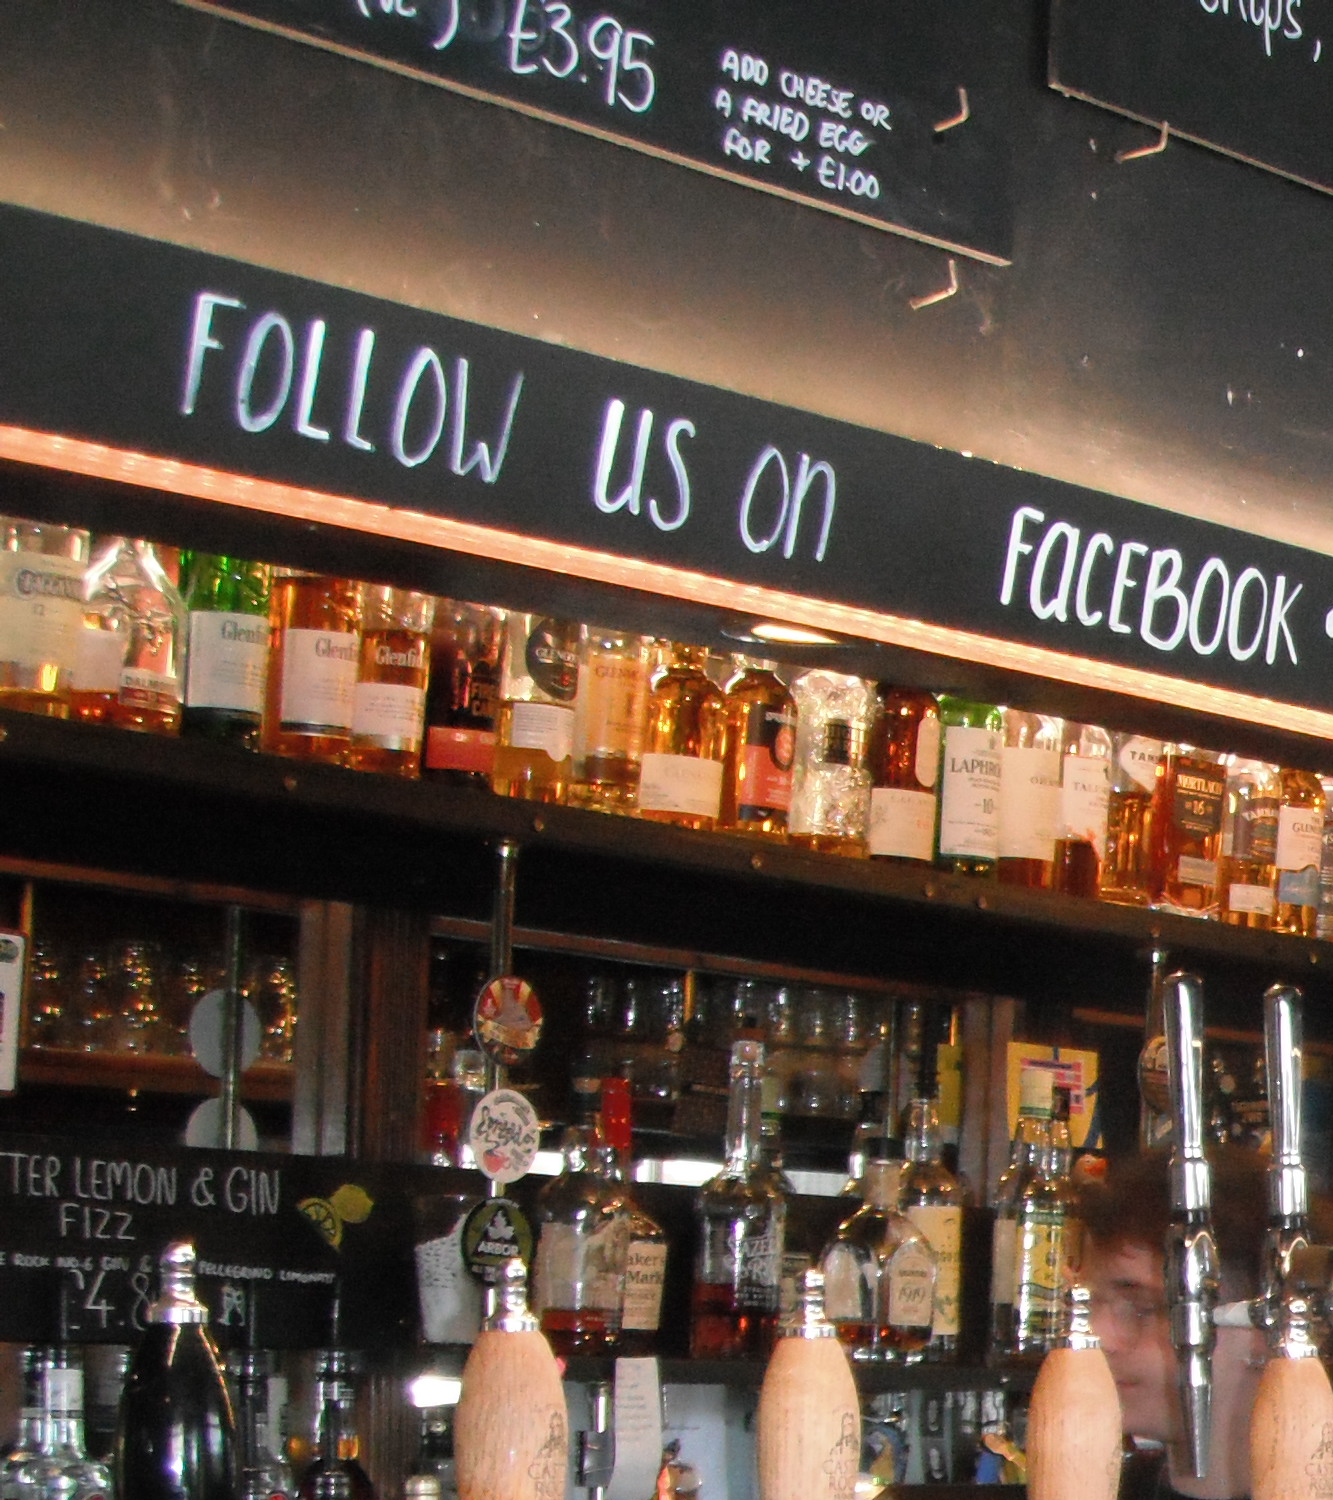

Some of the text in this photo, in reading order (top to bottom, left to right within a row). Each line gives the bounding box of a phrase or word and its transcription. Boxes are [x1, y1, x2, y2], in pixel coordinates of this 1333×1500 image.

[716, 90, 876, 155] A FRIED EGG
[722, 49, 891, 130] ADD CHEESE OR
[724, 127, 880, 199] FOR £1.00
[180, 291, 525, 485] FOLLOW
[594, 398, 697, 532] US
[74, 1157, 178, 1206] LEMON
[191, 1166, 217, 1207] &
[225, 1166, 281, 1216] GIN
[59, 1201, 137, 1241] FIZZ
